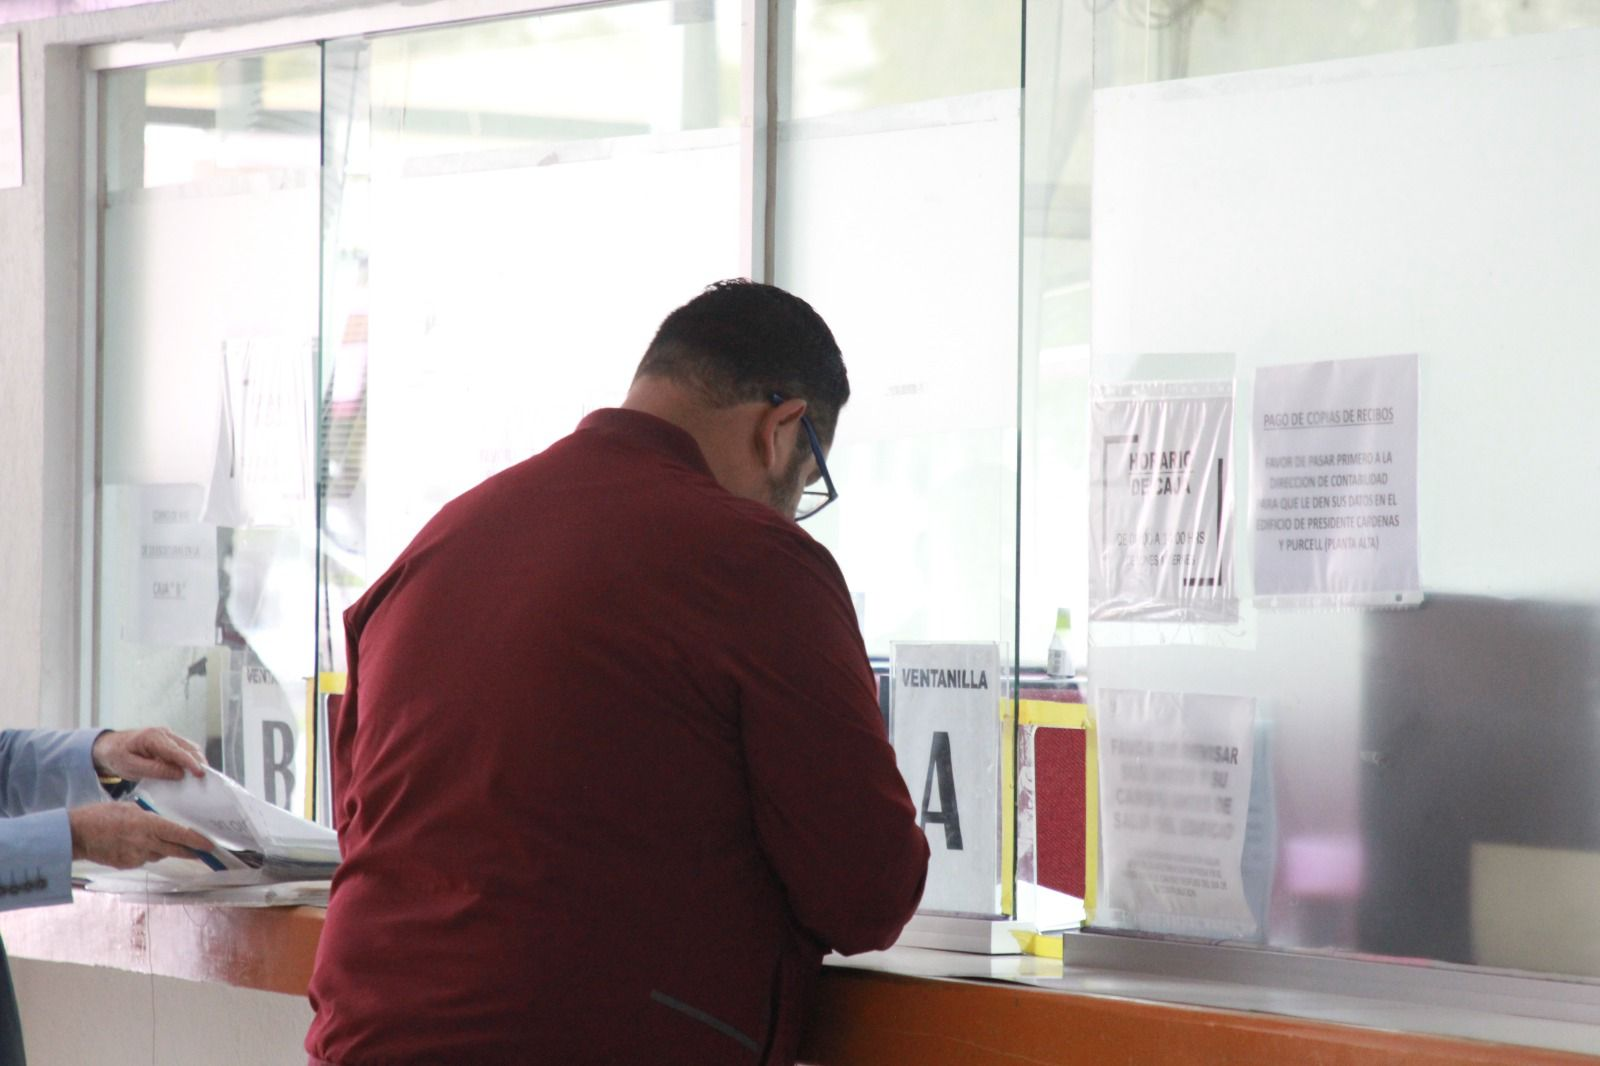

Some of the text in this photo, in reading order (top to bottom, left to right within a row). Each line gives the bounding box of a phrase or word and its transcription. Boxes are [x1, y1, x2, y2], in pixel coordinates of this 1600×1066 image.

[1264, 406, 1394, 426] PAGO DE COPIAS DE RECIBOS
[1265, 455, 1292, 468] FAVOR
[1309, 454, 1335, 466] PASAR
[1337, 452, 1373, 465] PRIMERO
[1375, 451, 1381, 464] A
[1382, 451, 1392, 464] LA
[1131, 478, 1150, 496] DE
[1270, 473, 1388, 488] DIRECCION DE CONTABILIDAD
[1259, 493, 1397, 510] ARA QUE LE DEN SUS DATOS EN EL
[1295, 517, 1305, 529] DE
[1308, 516, 1355, 529] PRESIDENTE
[1279, 535, 1380, 553] Y PURCELL (PLANTA ALTA)
[902, 668, 988, 689] VENTANILLA
[920, 731, 963, 850] A
